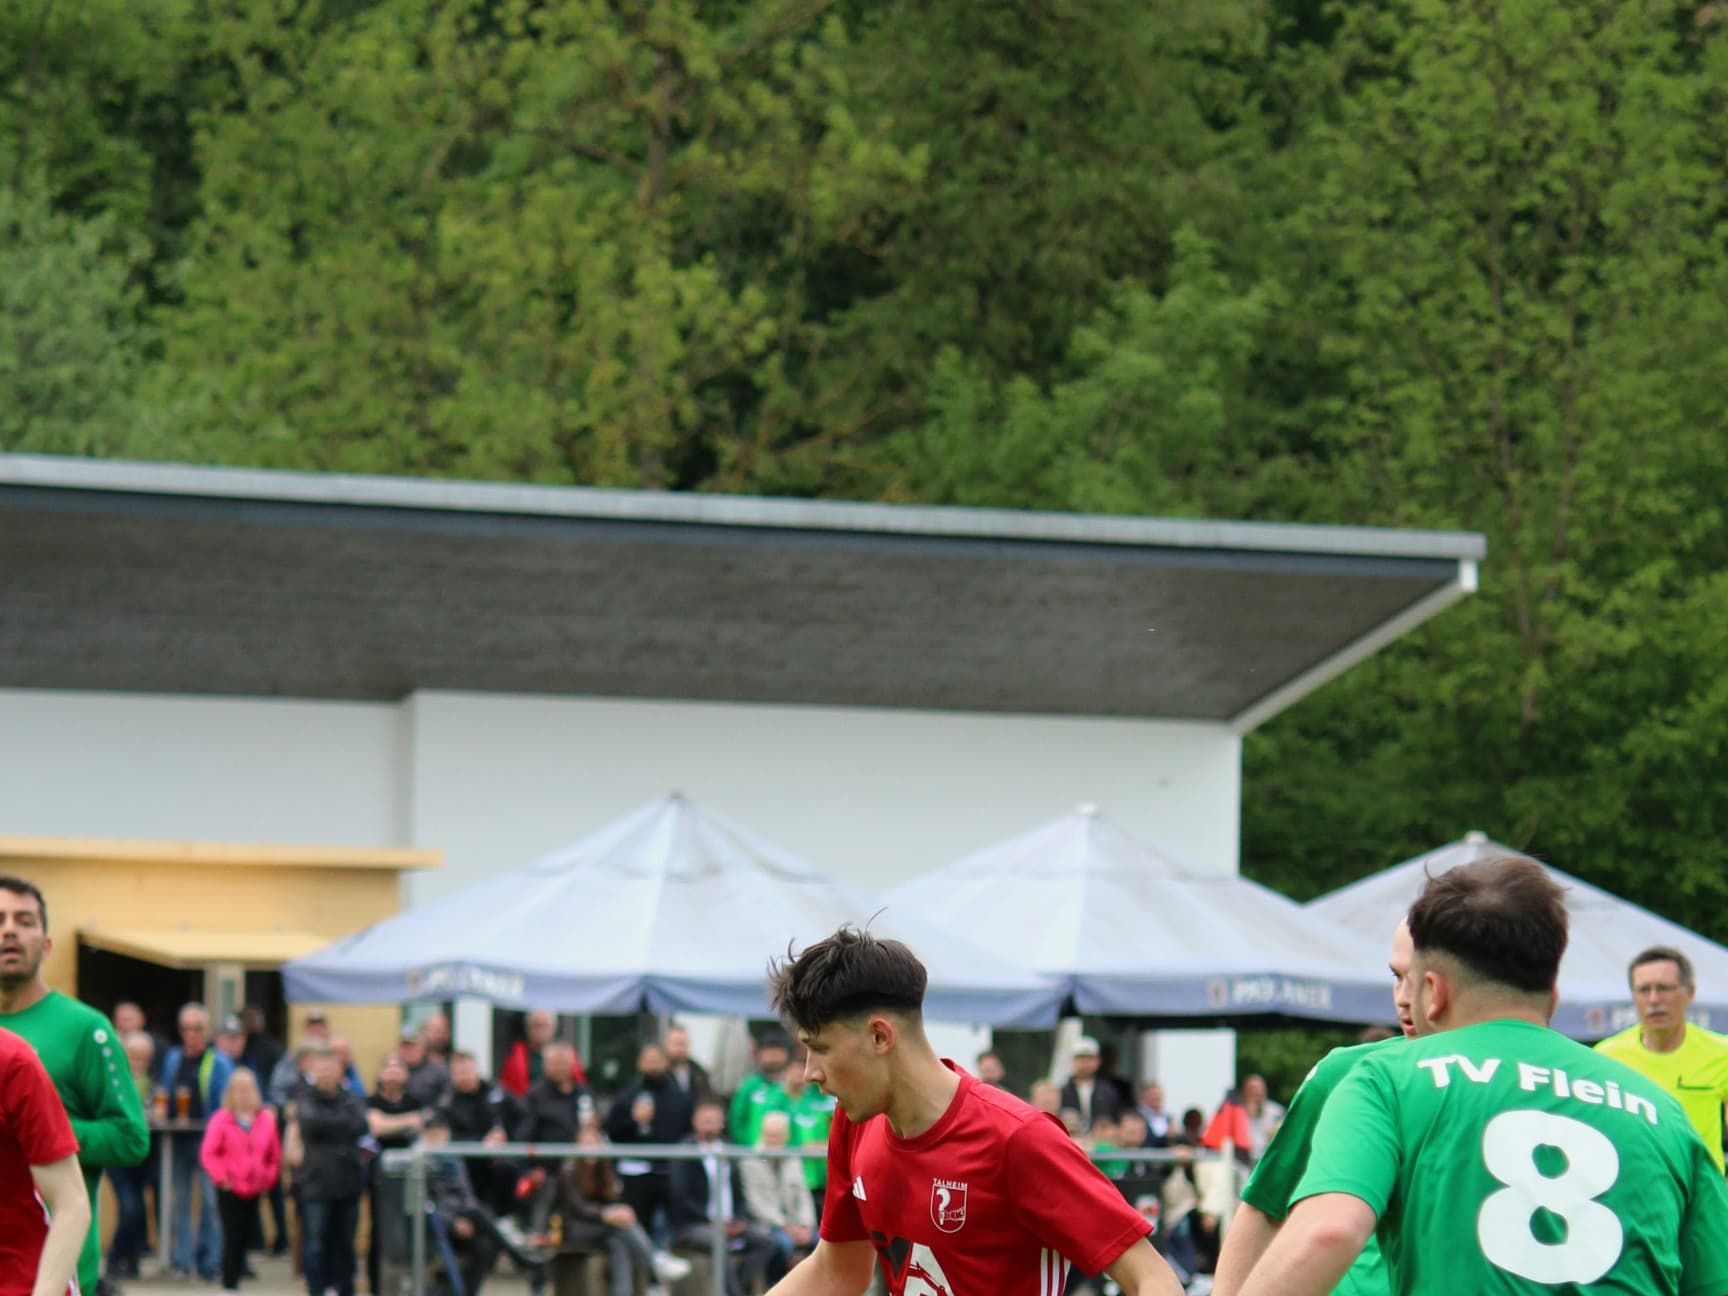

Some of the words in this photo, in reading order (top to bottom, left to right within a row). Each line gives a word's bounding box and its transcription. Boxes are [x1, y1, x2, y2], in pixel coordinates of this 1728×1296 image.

[1417, 1054, 1501, 1088] TV
[1517, 1062, 1658, 1125] Flein
[933, 1178, 968, 1190] TALHEIM
[1476, 1109, 1624, 1285] 8
